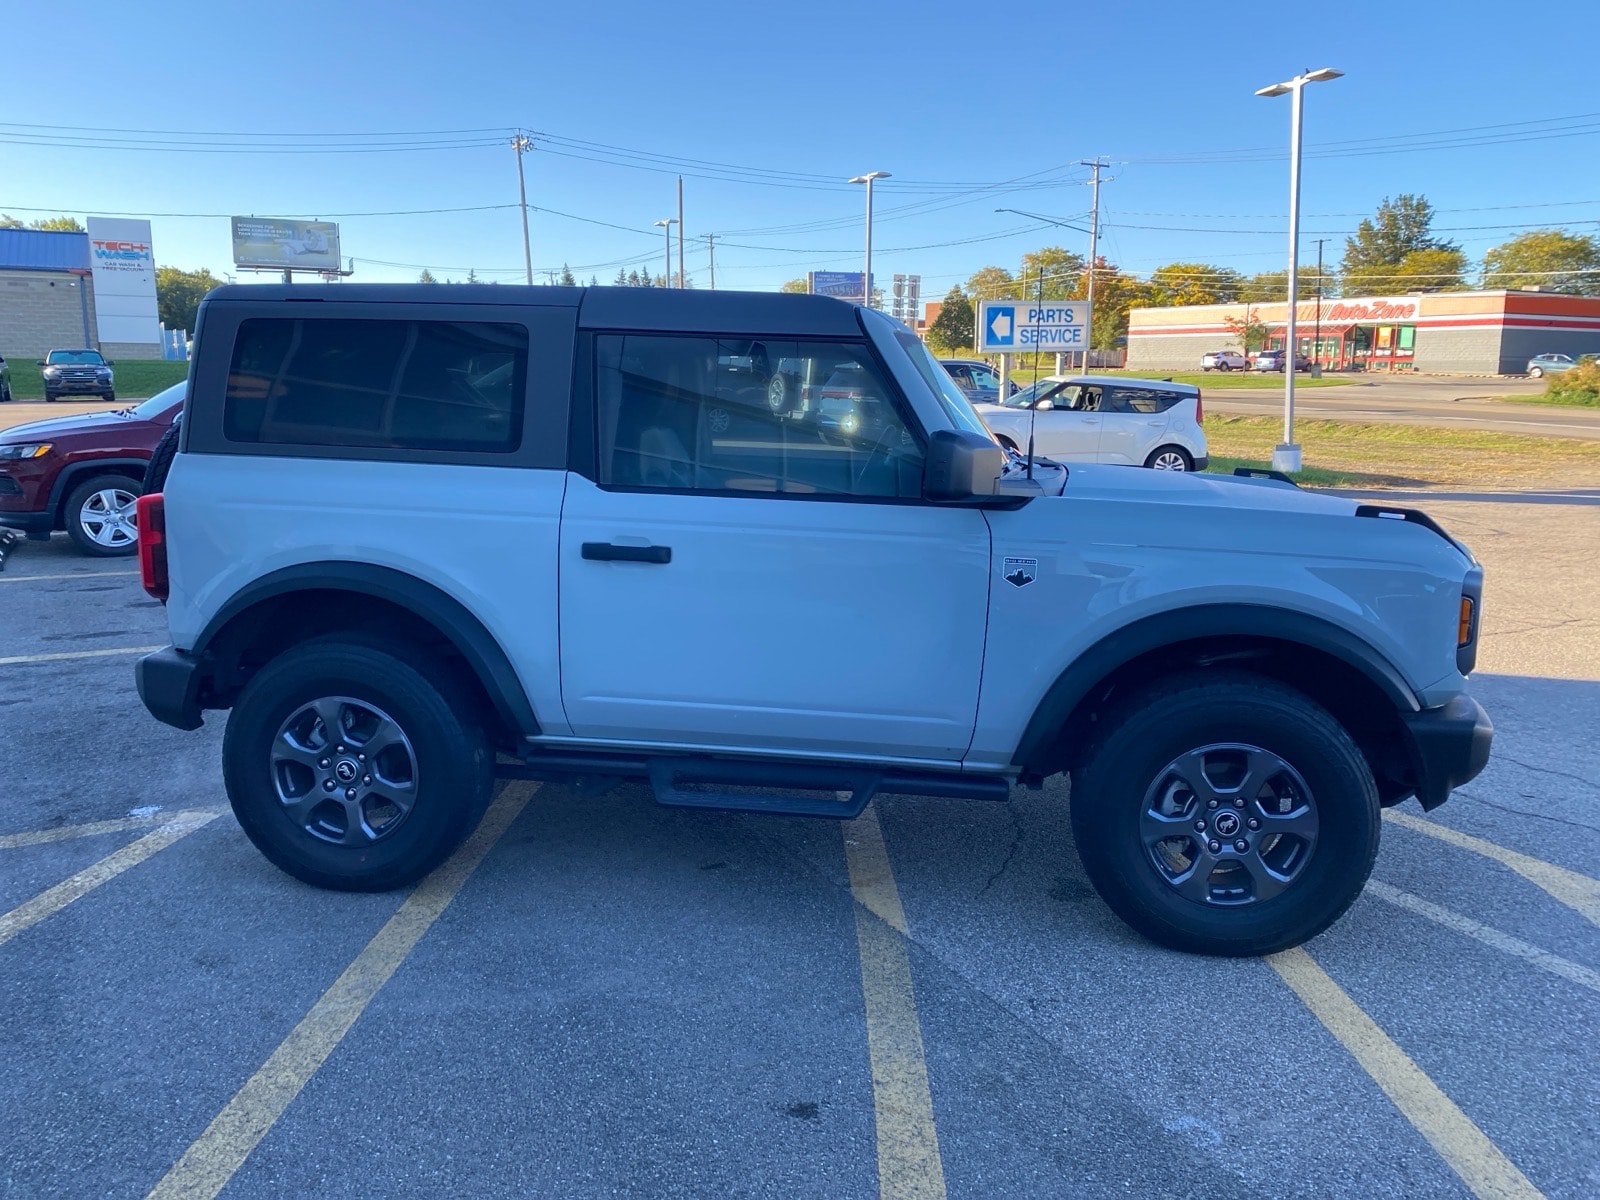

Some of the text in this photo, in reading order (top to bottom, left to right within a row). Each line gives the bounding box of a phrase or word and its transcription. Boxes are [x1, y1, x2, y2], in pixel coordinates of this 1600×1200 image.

[92, 241, 149, 252] TECH
[1028, 308, 1074, 323] PARTS
[1328, 301, 1416, 321] AutoZone
[1020, 328, 1082, 344] SERVICE
